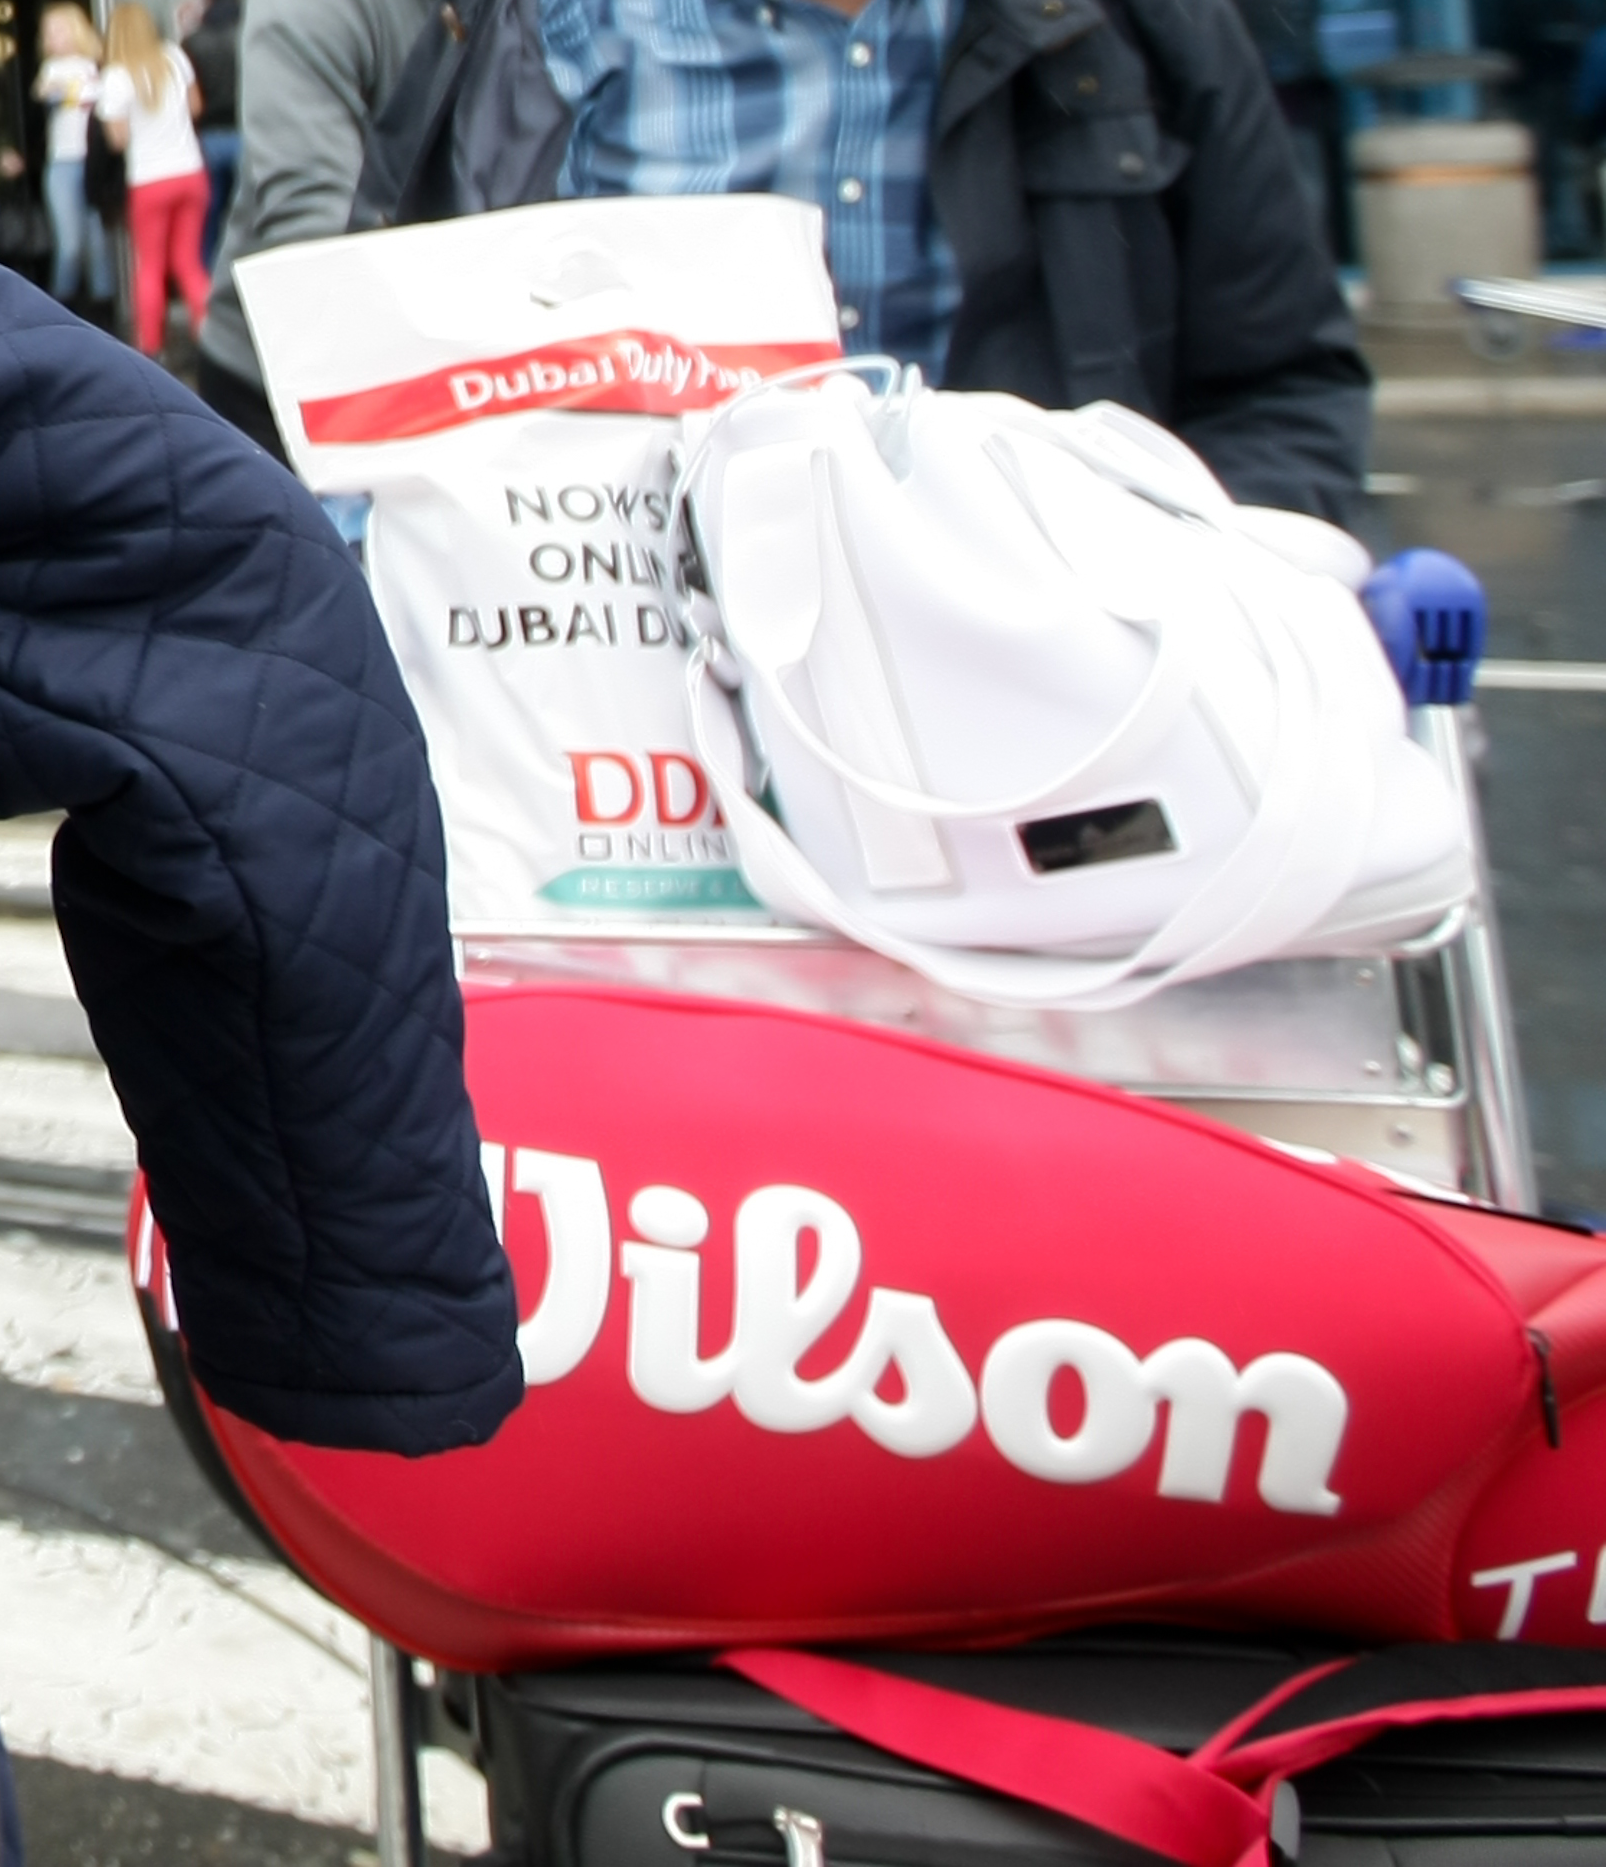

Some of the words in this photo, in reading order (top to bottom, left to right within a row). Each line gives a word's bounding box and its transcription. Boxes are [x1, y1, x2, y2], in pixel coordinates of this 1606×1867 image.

[449, 354, 616, 411] Dubai
[637, 604, 688, 650] DU
[565, 751, 726, 829] DD
[578, 832, 730, 862] ONLIN
[1469, 1543, 1606, 1641] T
